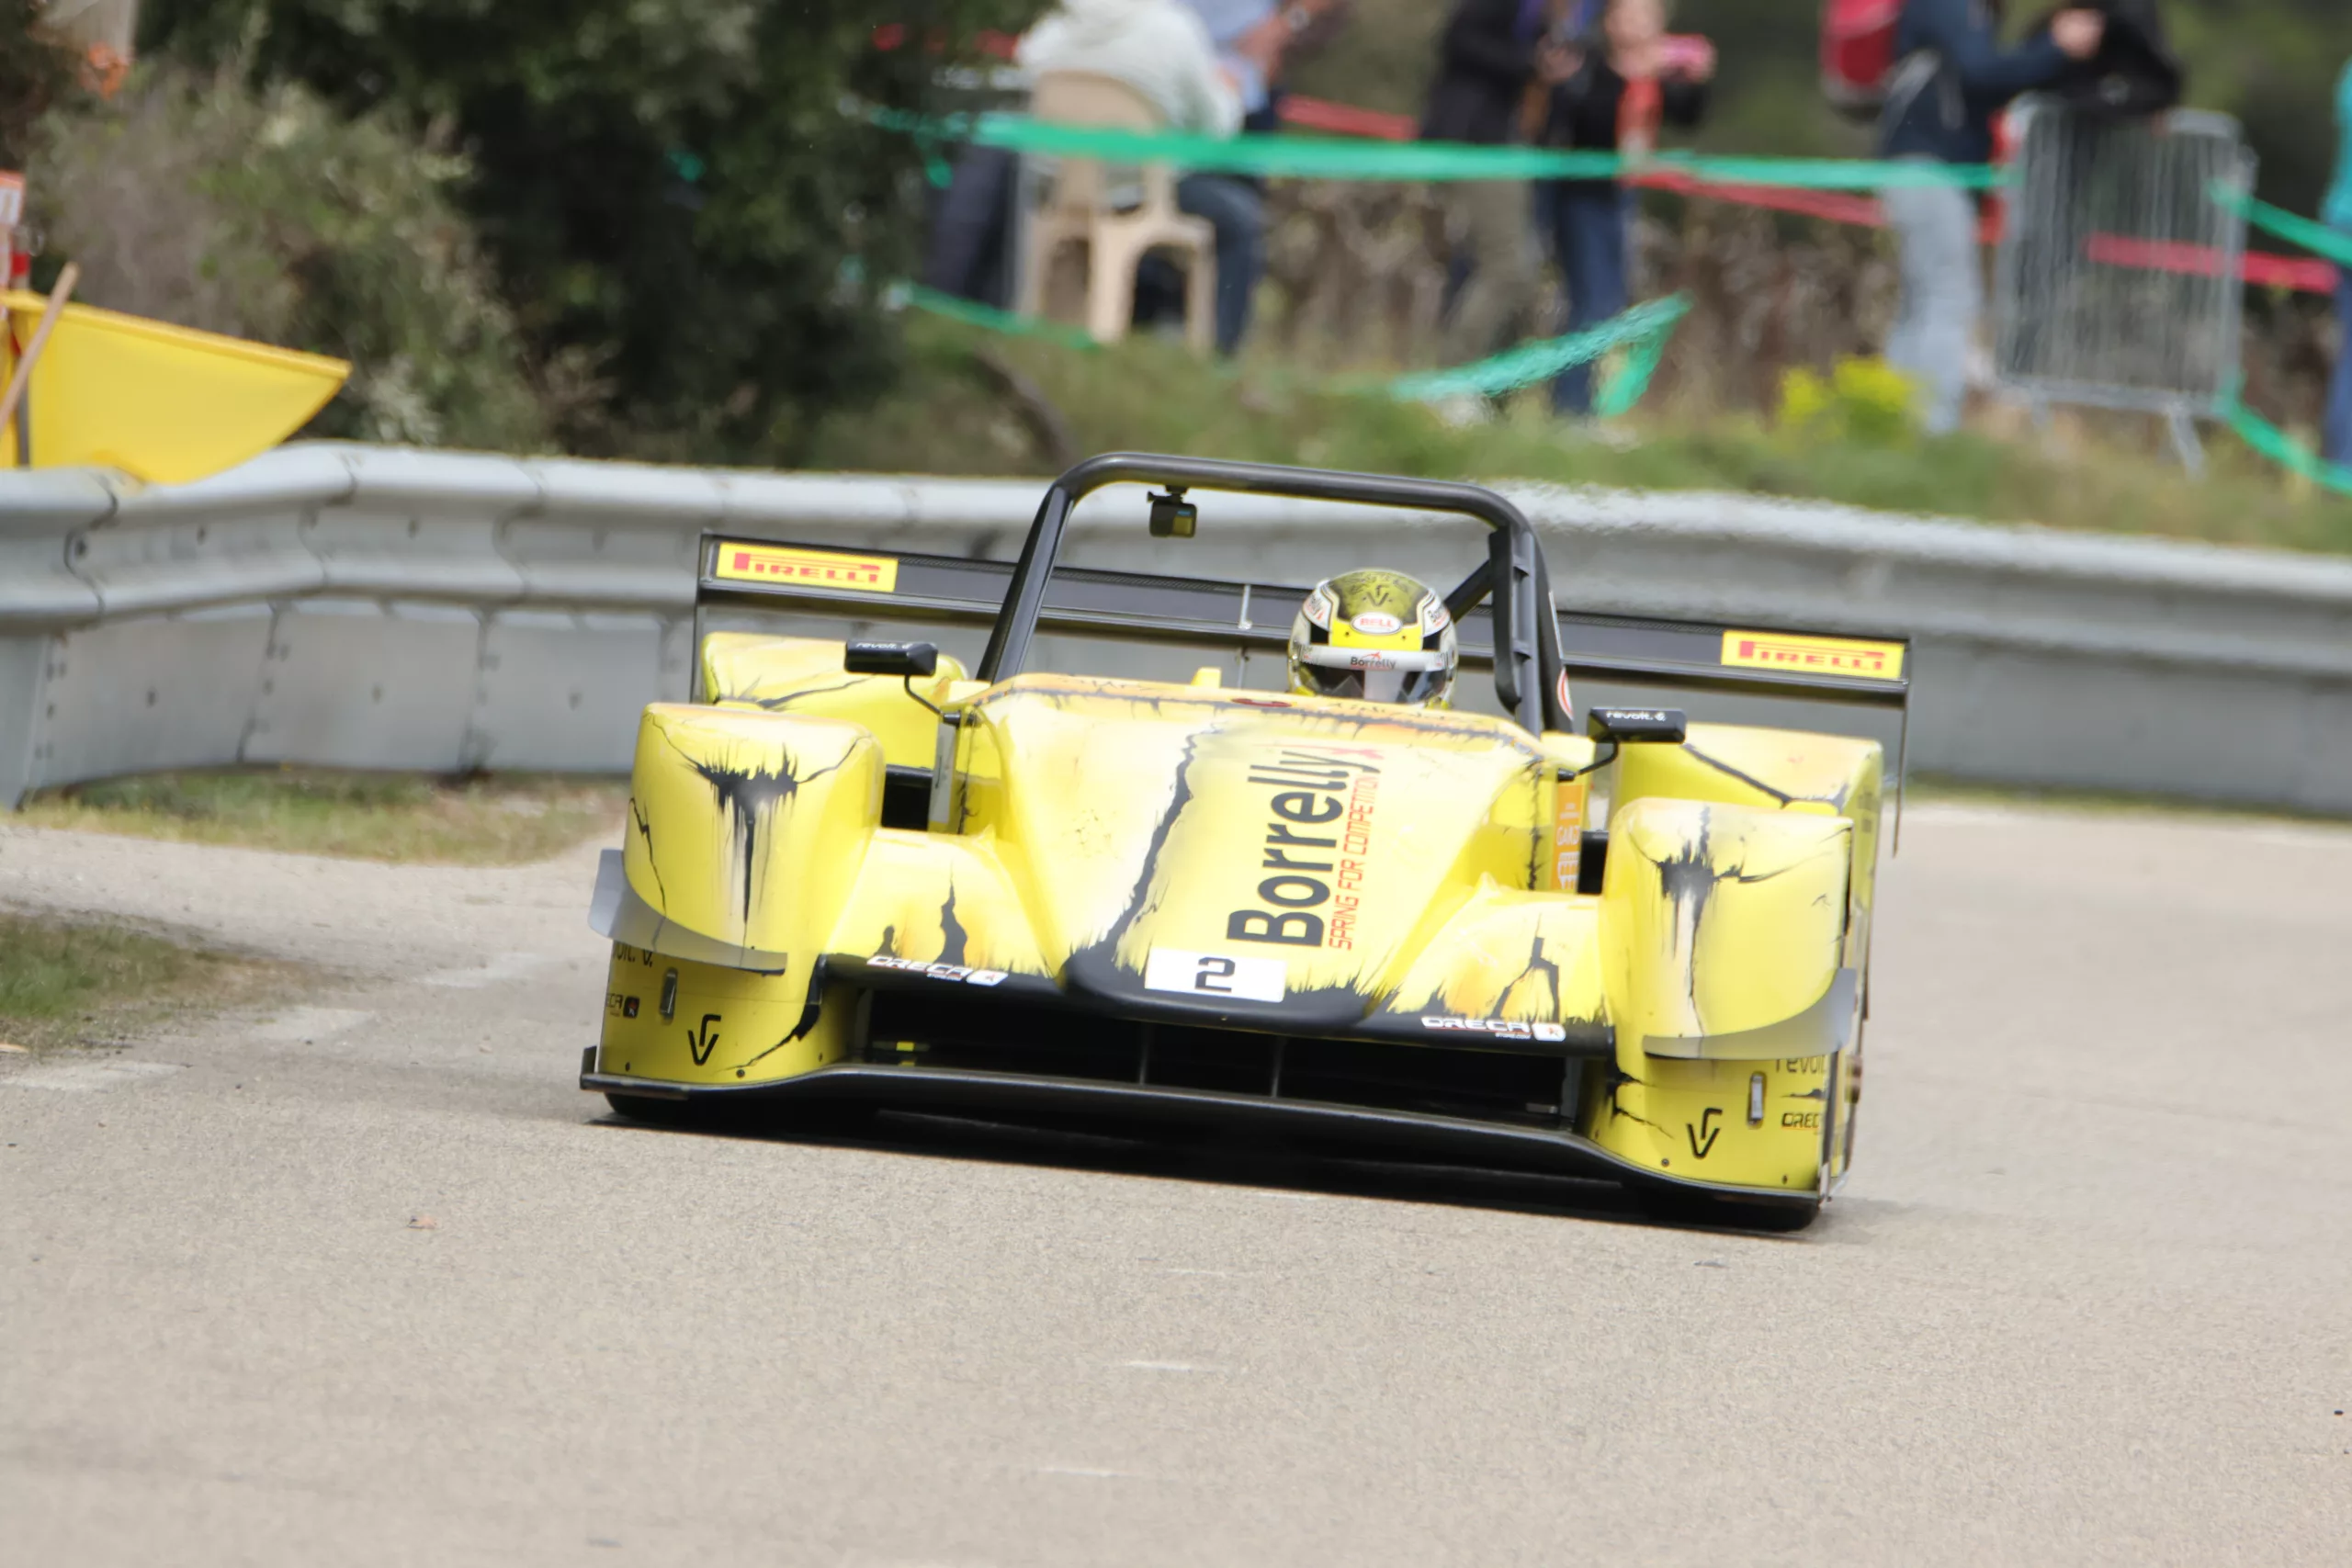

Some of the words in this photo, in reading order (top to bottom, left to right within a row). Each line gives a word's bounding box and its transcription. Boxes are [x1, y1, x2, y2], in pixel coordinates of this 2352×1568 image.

[734, 552, 880, 583] PIRELLI
[1359, 617, 1394, 628] BELL
[1351, 656, 1396, 670] Borrelly
[1739, 641, 1885, 671] PIRELLI
[1227, 750, 1381, 947] Borrelly
[1338, 859, 1364, 891] FOR
[1329, 895, 1359, 951] SPRING
[866, 955, 974, 976] ORECA
[1194, 956, 1236, 993] 2
[1421, 1016, 1531, 1033] ORECA
